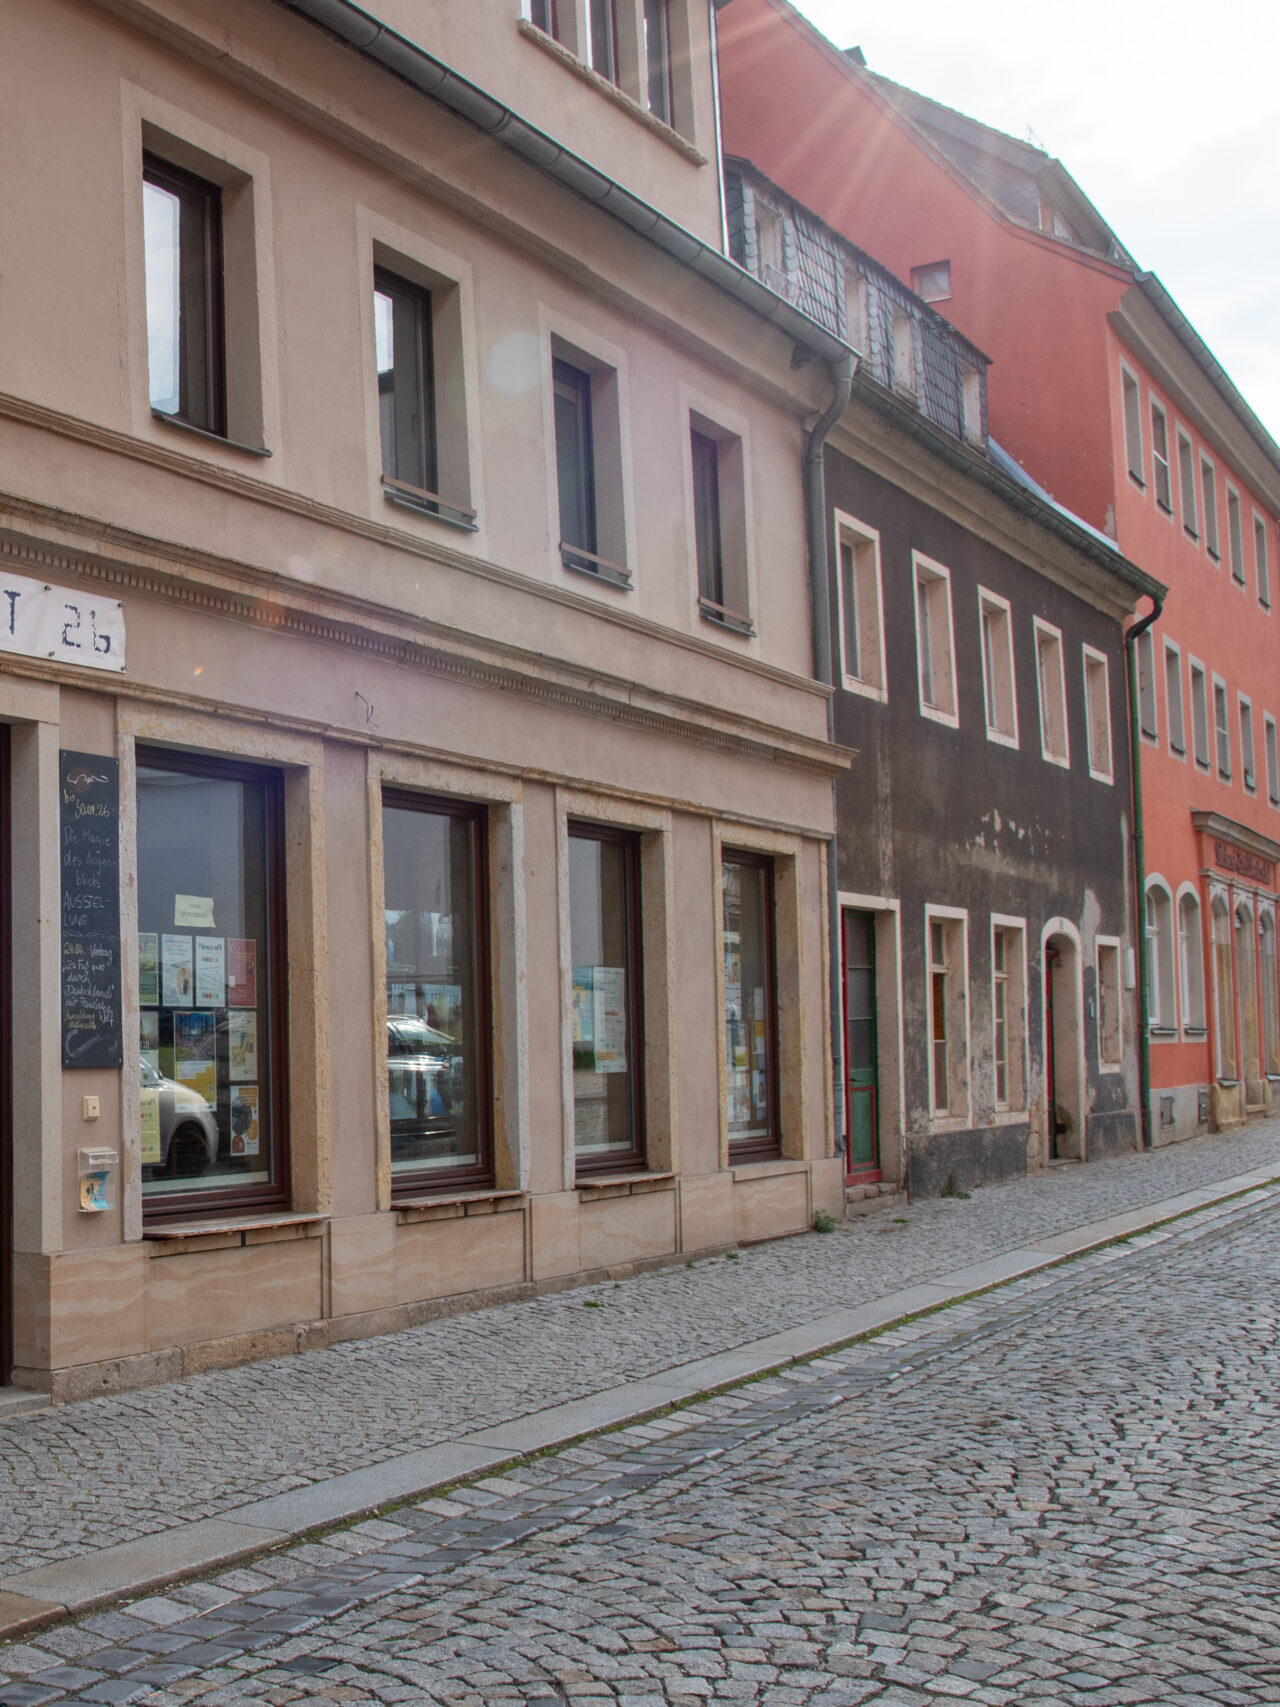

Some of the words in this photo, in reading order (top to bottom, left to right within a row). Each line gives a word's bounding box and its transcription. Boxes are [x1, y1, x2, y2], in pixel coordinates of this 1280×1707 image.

[64, 824, 80, 846] Die
[82, 828, 111, 853] Magie
[63, 853, 82, 867] des
[75, 868, 101, 889] blicks
[63, 912, 87, 927] LUNG
